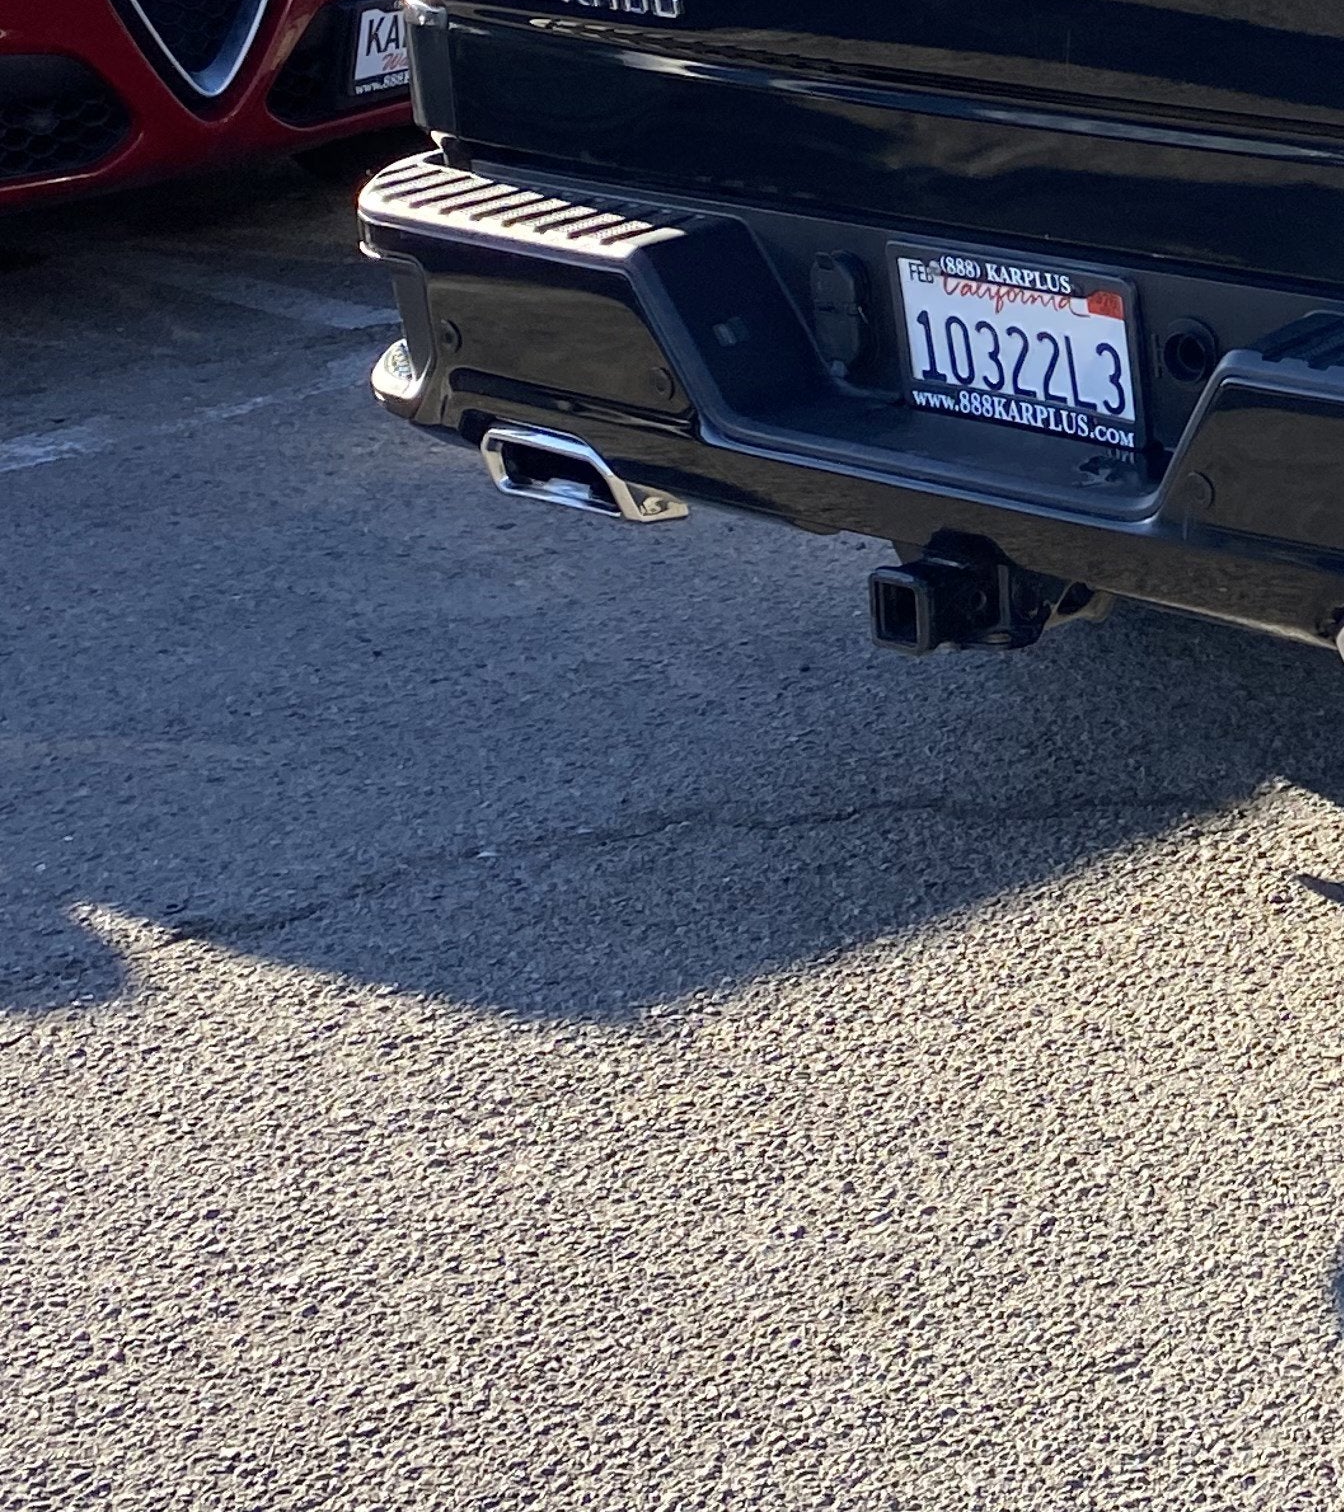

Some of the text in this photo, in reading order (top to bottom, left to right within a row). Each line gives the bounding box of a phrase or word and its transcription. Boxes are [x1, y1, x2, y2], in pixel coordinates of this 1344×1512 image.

[939, 256, 1072, 295] (888) KARPLUS
[943, 276, 1091, 318] California
[917, 310, 1126, 415] 10322L3
